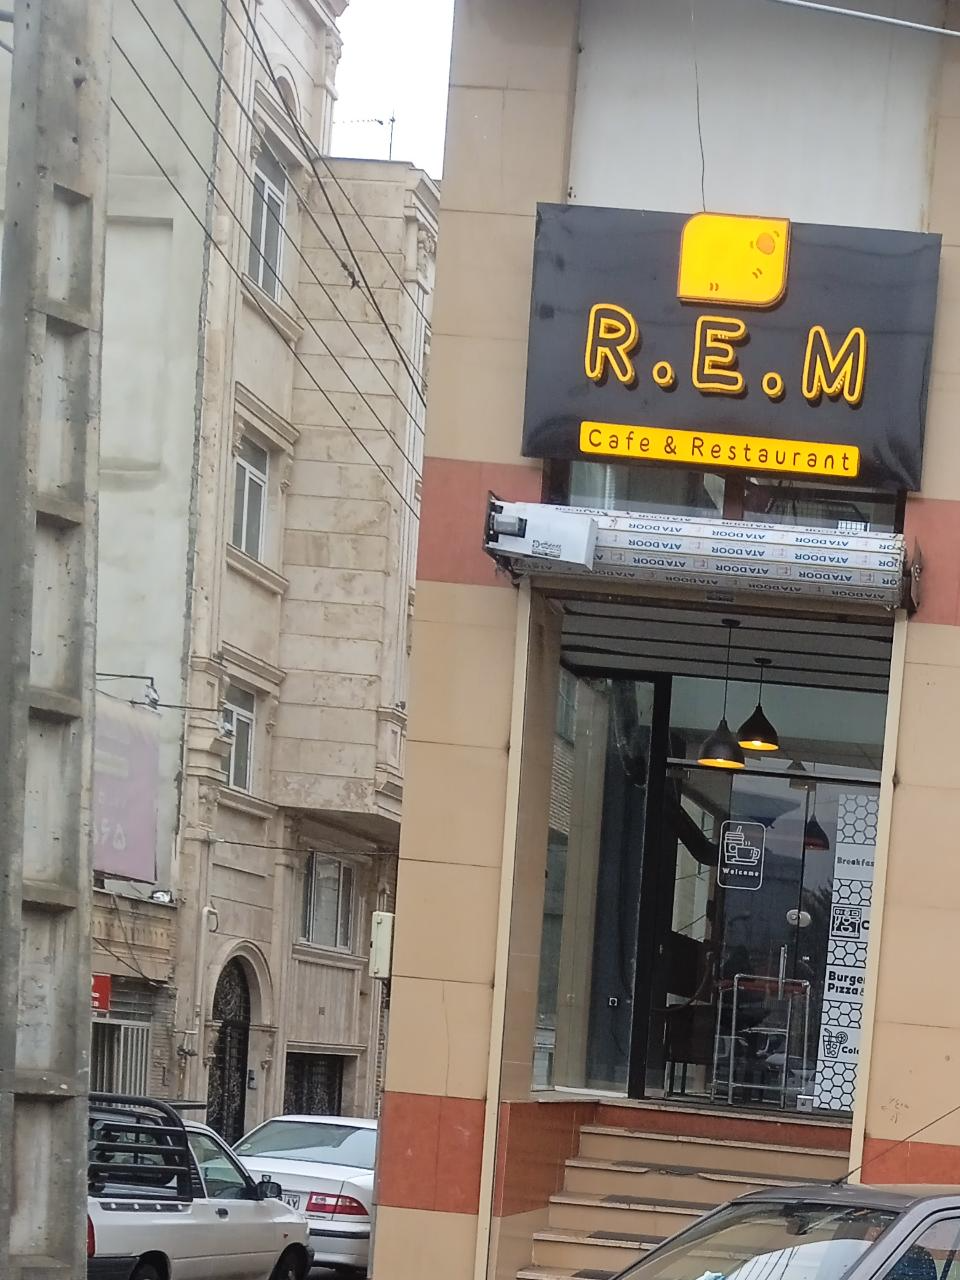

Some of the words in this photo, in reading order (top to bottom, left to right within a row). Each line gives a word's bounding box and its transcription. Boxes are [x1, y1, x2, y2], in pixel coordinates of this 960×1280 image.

[583, 303, 866, 405] R.E.M
[588, 428, 651, 453] Cafe
[663, 435, 678, 455] &
[691, 436, 850, 471] Restaurant
[629, 523, 660, 531] DOOR
[712, 530, 743, 538] DOOR
[628, 538, 660, 549] DOOR
[795, 537, 827, 545] DOOR
[661, 542, 682, 550] ATA
[712, 546, 743, 556] DOOR
[744, 550, 765, 558] ATA
[633, 556, 664, 566] DOOR
[795, 553, 826, 563] DOOR
[828, 556, 849, 564] ATA
[666, 560, 686, 568] ATA
[715, 563, 747, 573] DOOR
[748, 567, 769, 575] ATA
[798, 571, 830, 580] DOOR
[832, 574, 853, 582] ATA
[827, 982, 859, 996] Pizza
